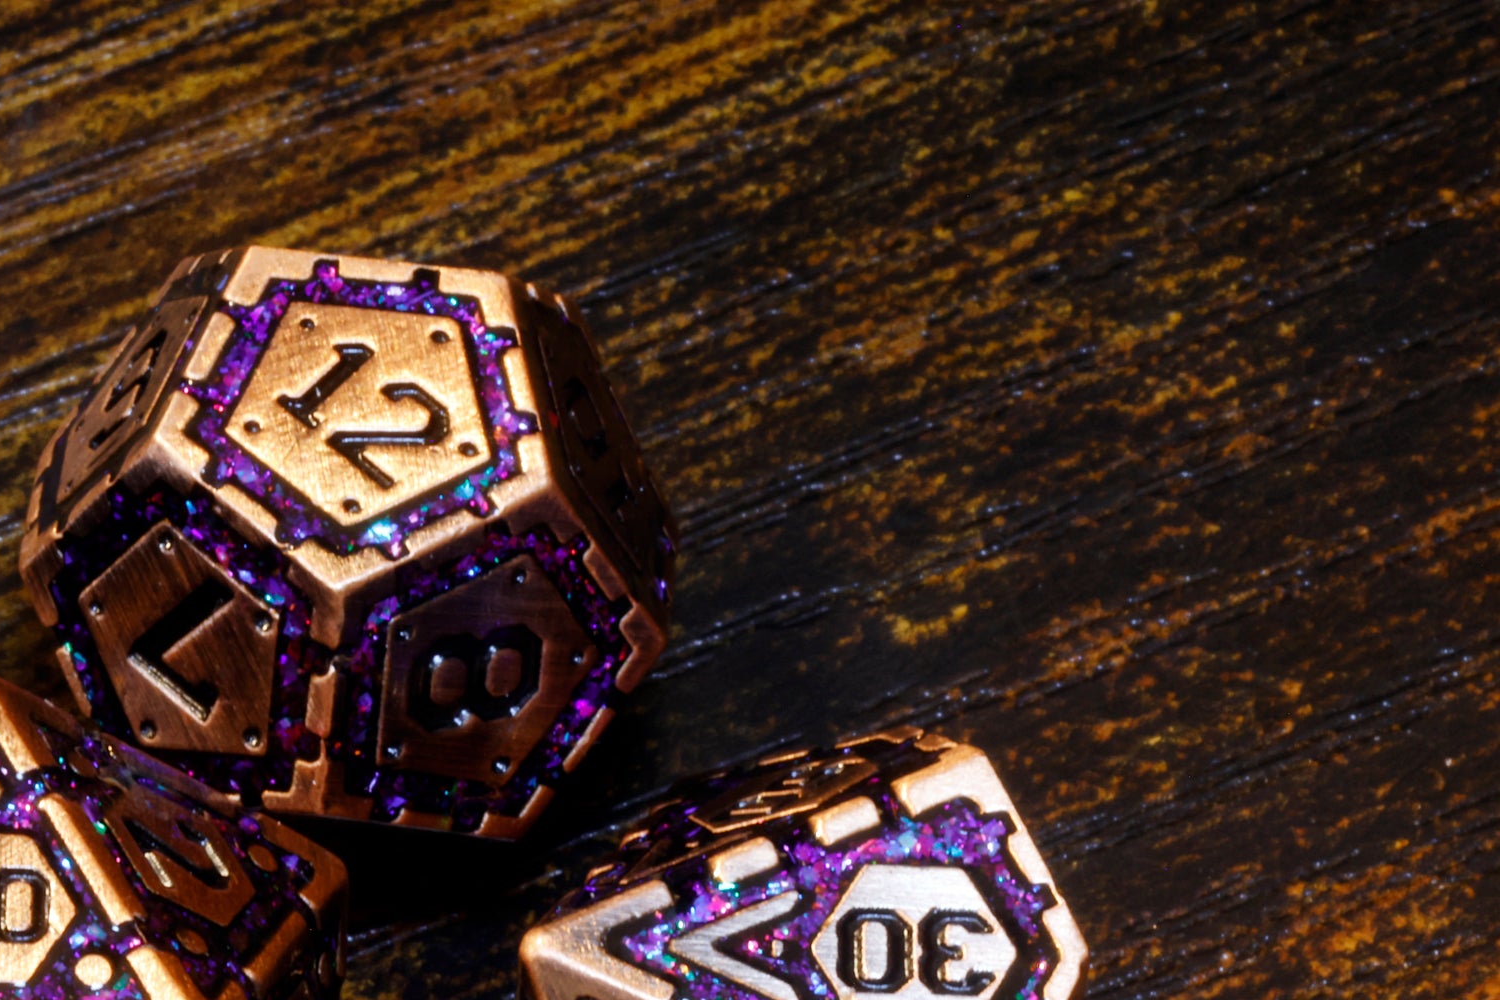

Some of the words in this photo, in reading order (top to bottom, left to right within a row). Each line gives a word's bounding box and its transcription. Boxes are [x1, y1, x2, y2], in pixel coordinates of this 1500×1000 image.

[276, 342, 450, 490] 12
[126, 578, 234, 723] 7
[405, 623, 544, 733] 8
[836, 907, 995, 995] 30
